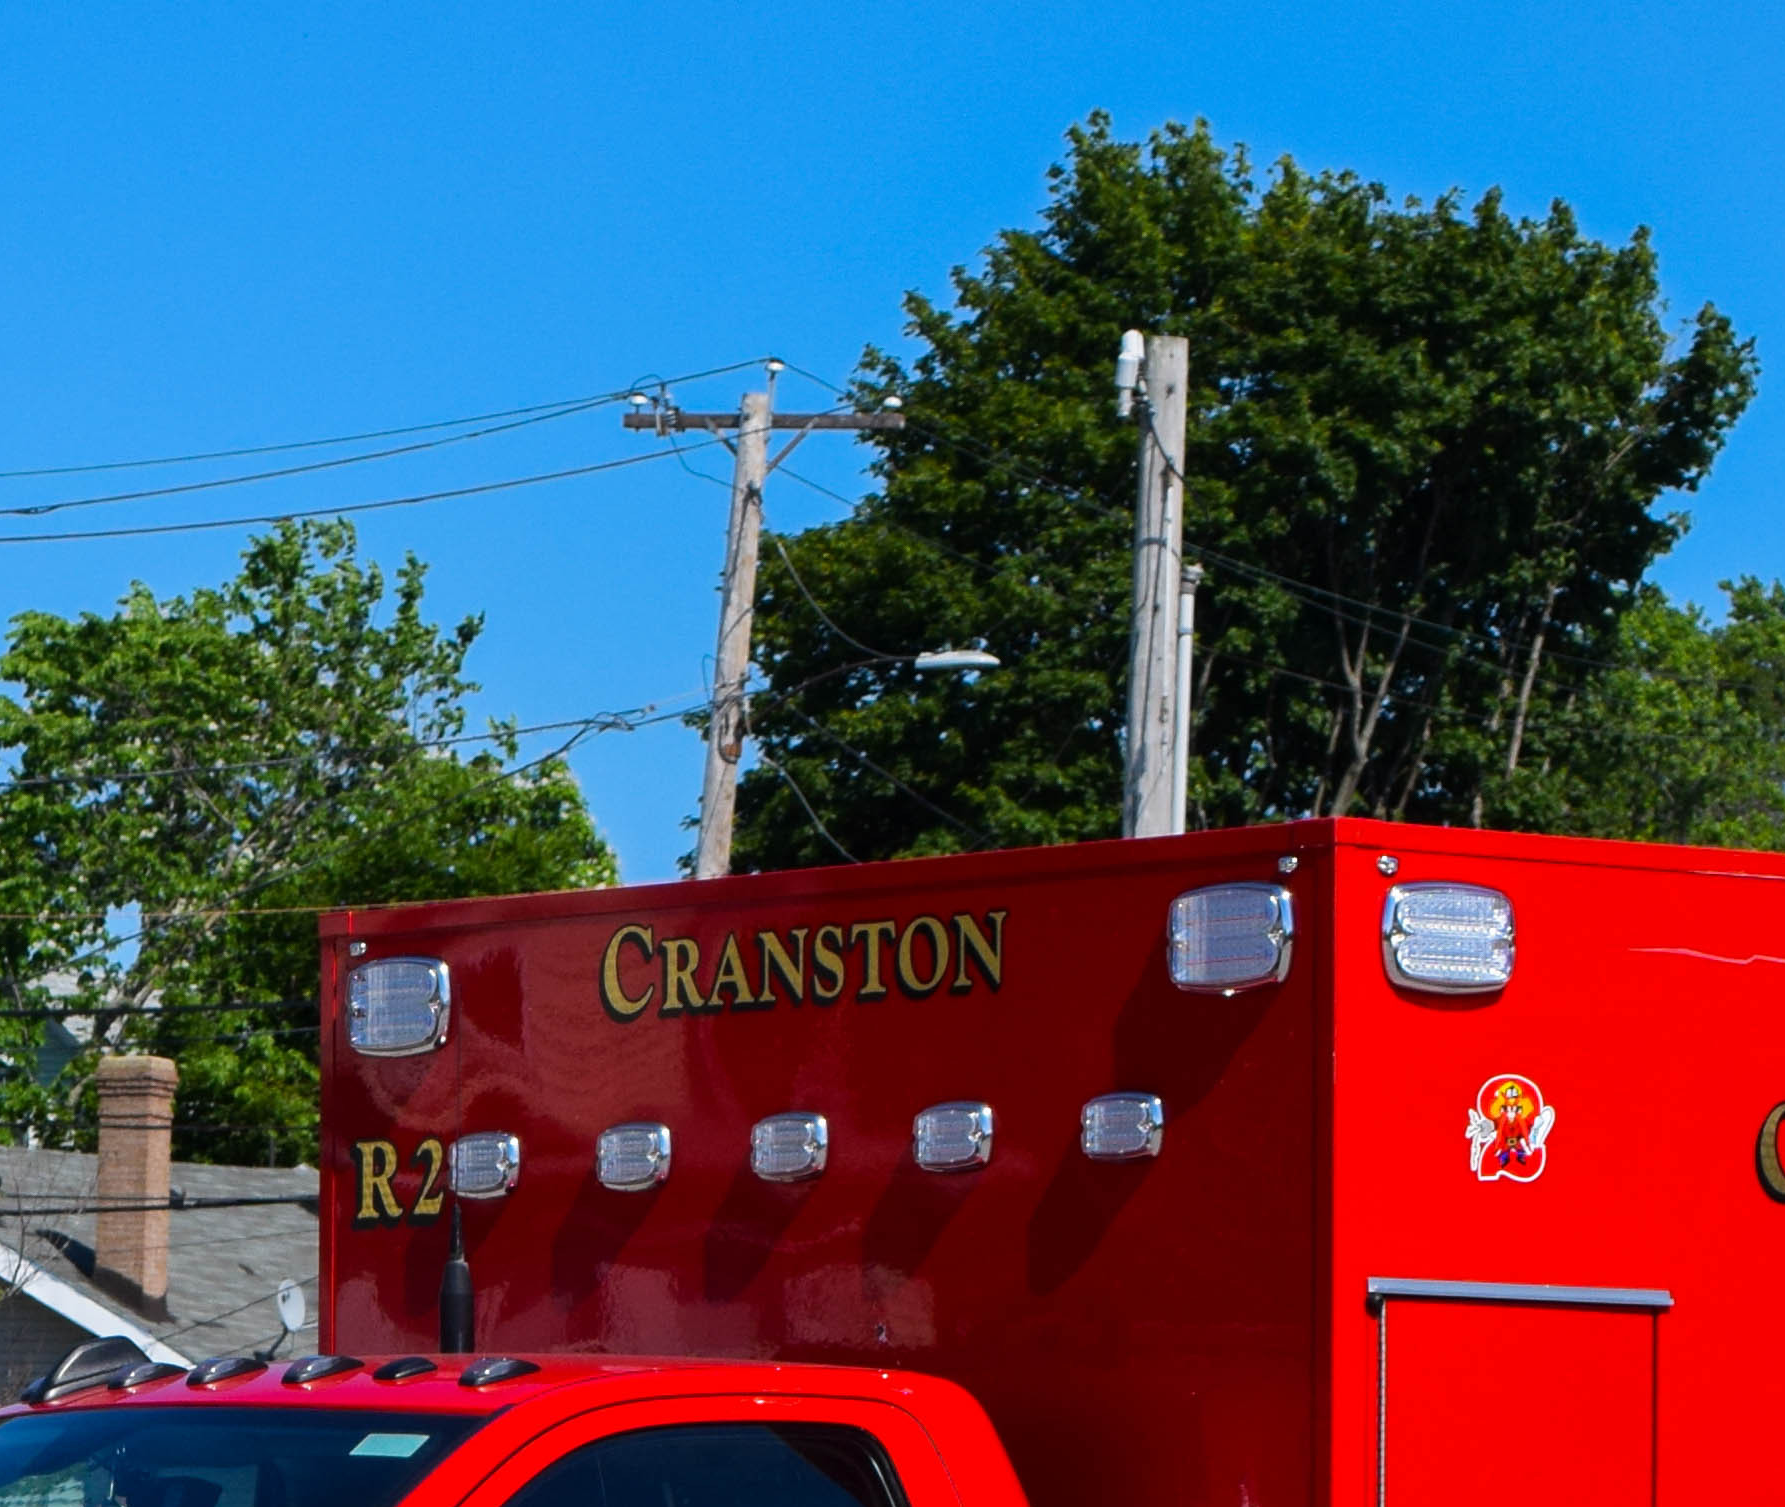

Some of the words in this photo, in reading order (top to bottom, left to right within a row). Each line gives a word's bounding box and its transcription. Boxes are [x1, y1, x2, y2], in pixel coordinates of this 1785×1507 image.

[600, 911, 1007, 1022] CRANSTON
[351, 1139, 403, 1230] R
[410, 1138, 444, 1226] 2
